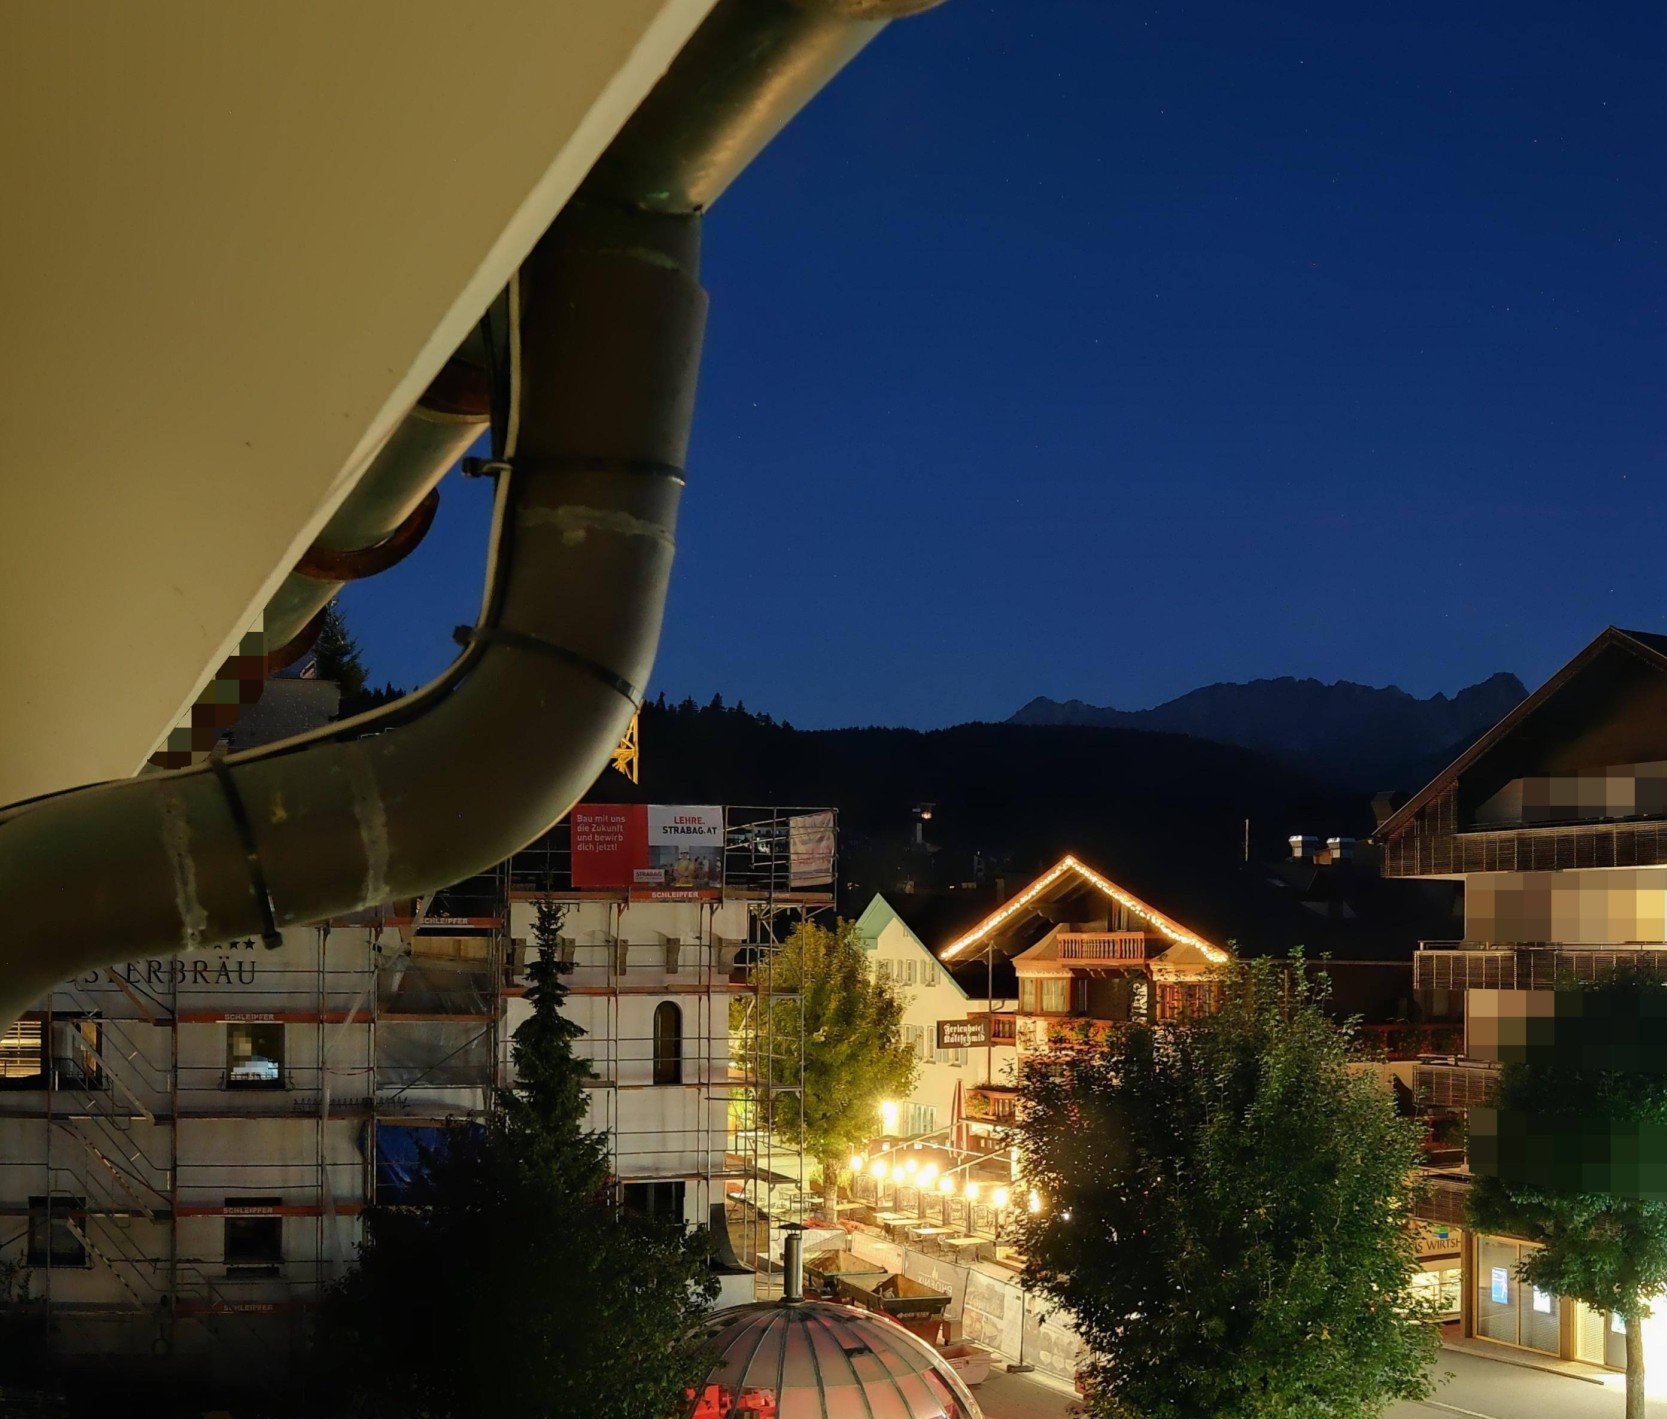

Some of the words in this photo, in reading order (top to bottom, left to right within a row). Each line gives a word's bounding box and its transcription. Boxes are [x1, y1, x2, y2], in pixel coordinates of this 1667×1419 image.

[577, 814, 593, 823] Bau
[594, 814, 608, 823] mit
[610, 815, 626, 823] uns
[674, 816, 705, 825] LEHRE.
[577, 824, 590, 832] die
[591, 824, 624, 833] Zukunft
[662, 826, 717, 835] STRABAG.AT
[577, 833, 592, 842] und
[594, 833, 624, 842] bewirb
[577, 842, 595, 851] dich
[597, 842, 618, 852] jetzt!
[651, 891, 699, 899] SCHLEIPFER
[420, 917, 469, 925] SCHLEIPFER
[224, 1013, 275, 1021] SCHLEIPFER
